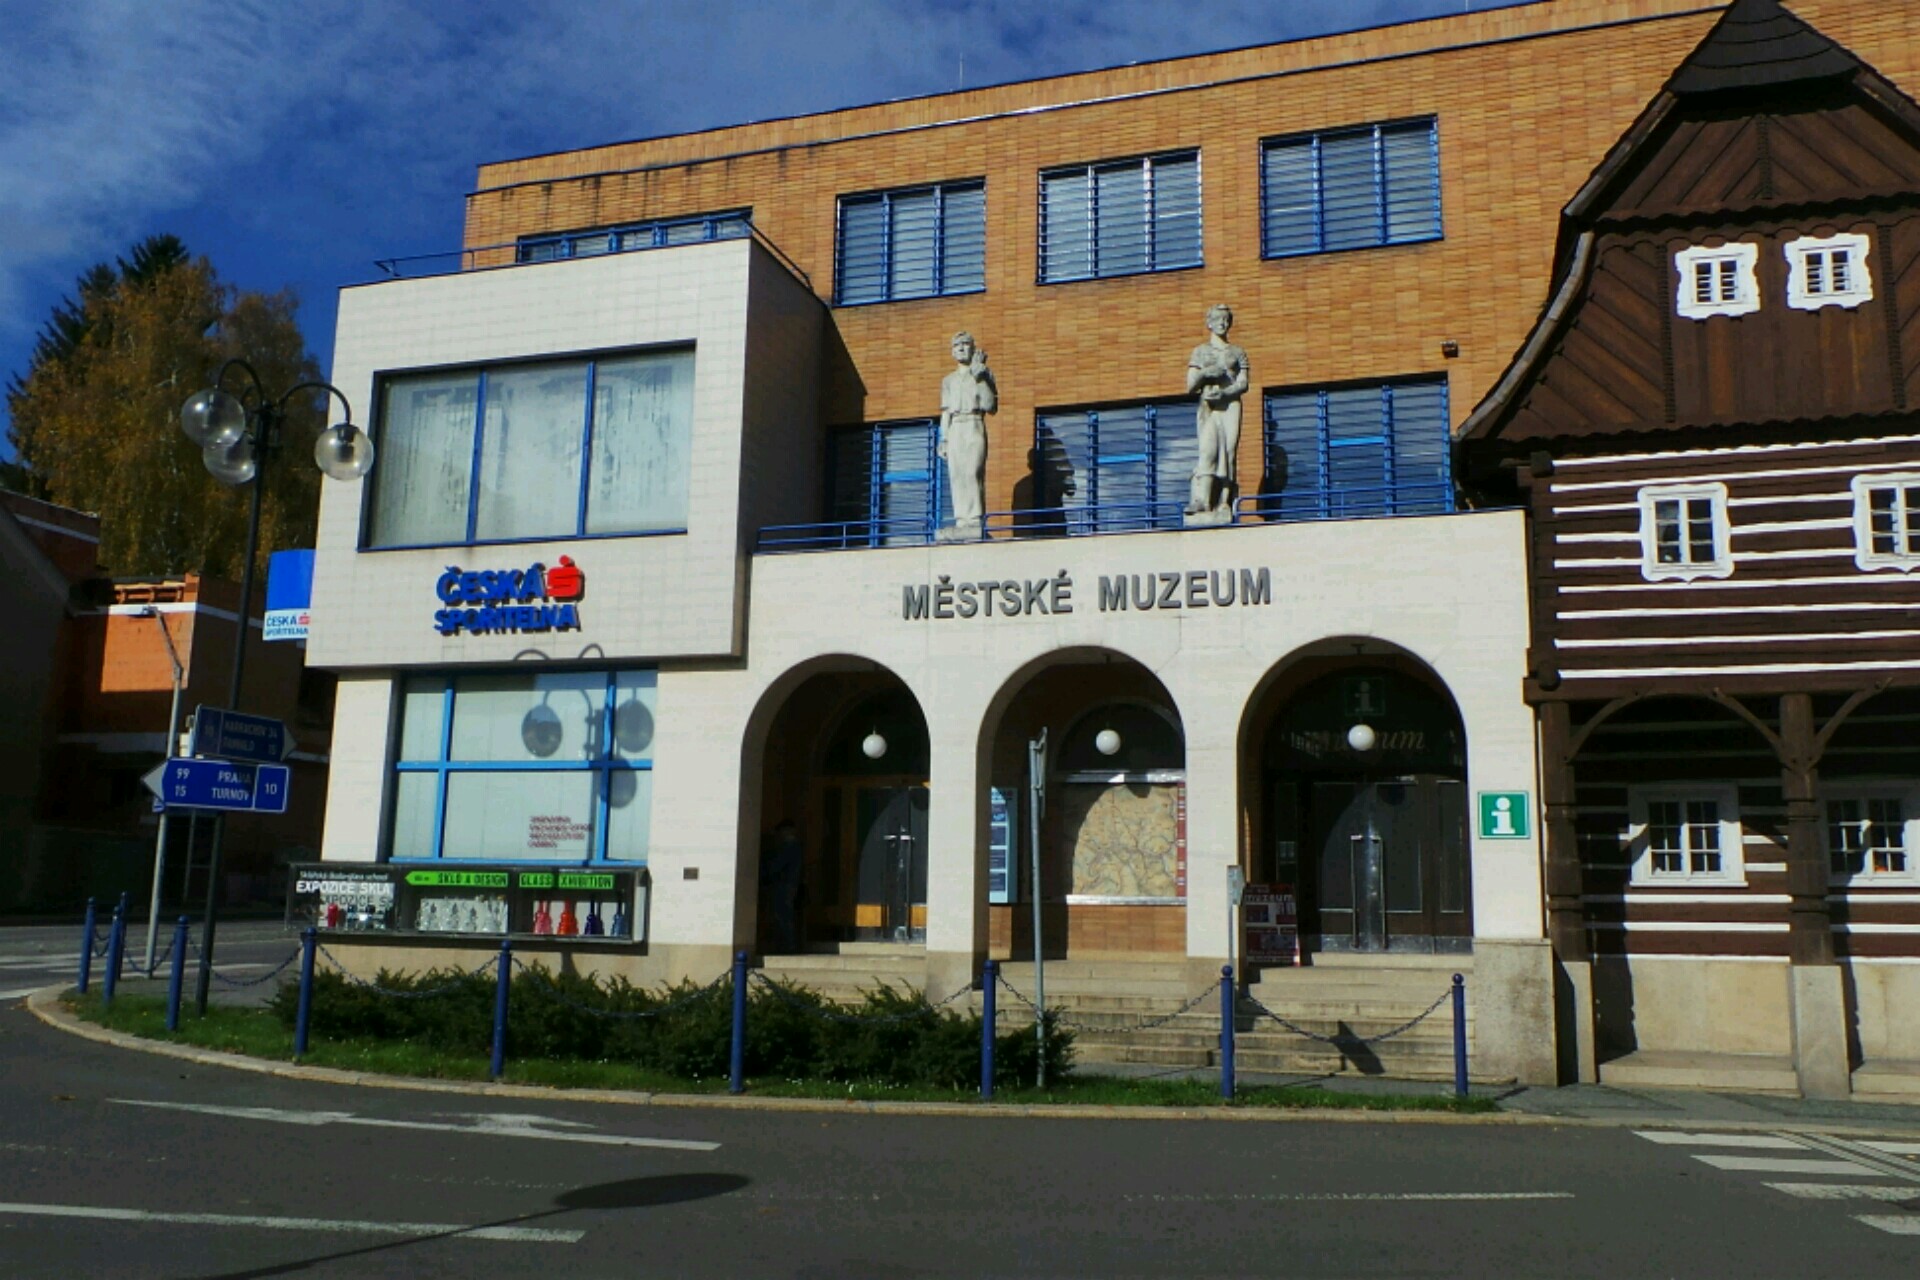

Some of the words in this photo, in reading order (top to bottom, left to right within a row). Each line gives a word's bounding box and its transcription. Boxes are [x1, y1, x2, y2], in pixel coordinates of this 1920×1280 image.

[436, 562, 547, 605] ČESKÁ
[902, 569, 1073, 620] MĚSTSKÉ
[1098, 566, 1271, 612] MUZEUM
[433, 601, 581, 636] SPOŘITELNA
[176, 767, 191, 780] 99
[217, 769, 252, 783] PRAHA
[174, 784, 187, 797] 15
[211, 787, 250, 801] TURNOV
[264, 783, 278, 795] 10
[296, 880, 355, 894] EXPOZICE
[474, 874, 507, 886] DESIGN
[521, 874, 552, 886] GLASS
